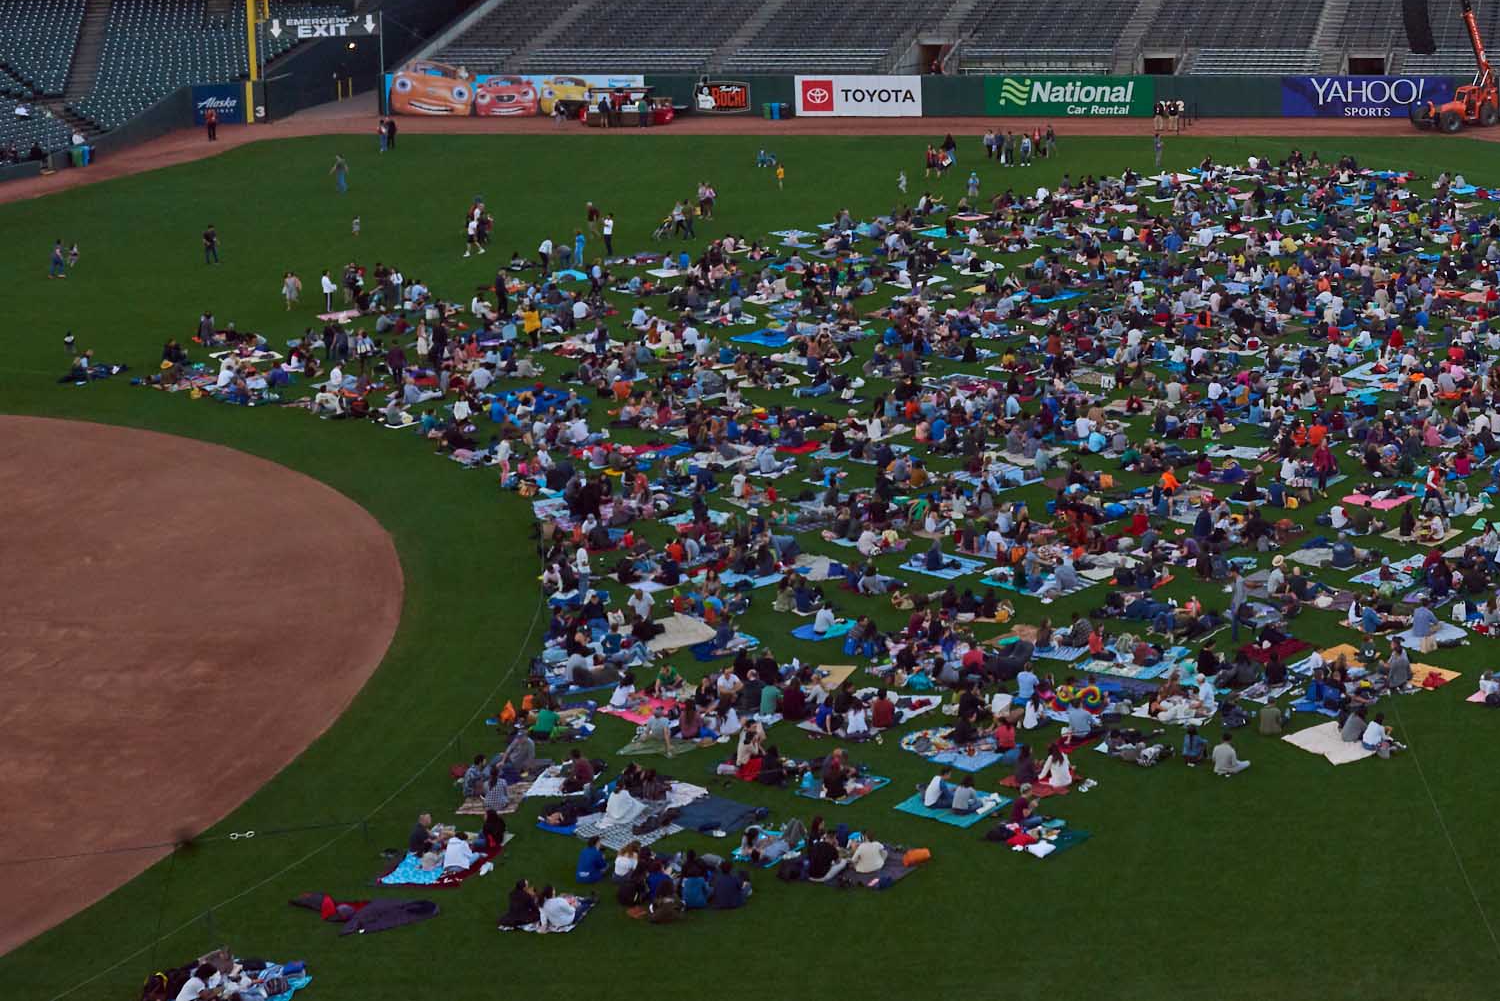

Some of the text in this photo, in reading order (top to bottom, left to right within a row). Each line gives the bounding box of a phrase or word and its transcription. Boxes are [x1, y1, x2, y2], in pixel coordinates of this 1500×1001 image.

[286, 15, 360, 26] EMERGENCY
[297, 23, 350, 38] EXIT
[841, 88, 915, 103] TOYOTA
[1031, 80, 1132, 103] National
[1310, 78, 1424, 106] YAHOO!
[197, 97, 238, 109] Alaska
[1066, 105, 1129, 115] Car Rental
[1344, 106, 1391, 118] SPORTS
